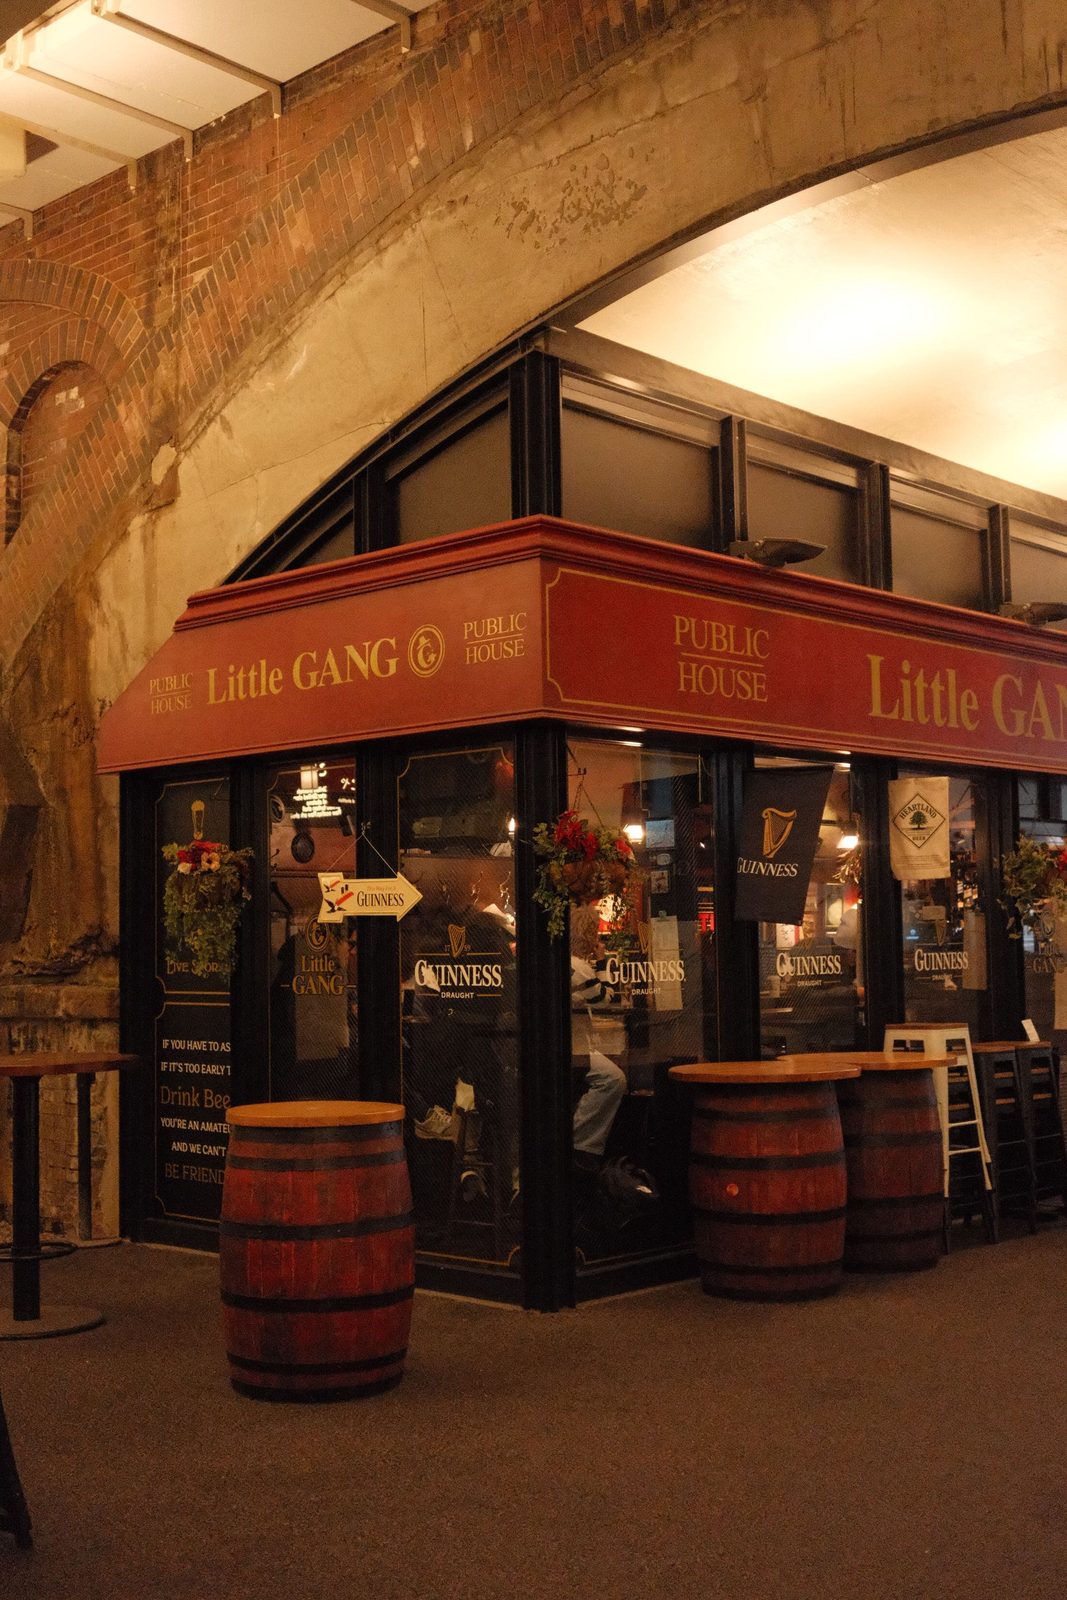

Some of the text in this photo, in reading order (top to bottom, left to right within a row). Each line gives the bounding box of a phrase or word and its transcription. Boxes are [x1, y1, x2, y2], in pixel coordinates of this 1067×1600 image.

[463, 612, 527, 640] PUBLIC
[673, 615, 770, 660] PUBLIC
[465, 638, 526, 666] HOUSE
[205, 637, 400, 705] Little GANG
[149, 672, 194, 695] PUBLIC
[677, 661, 769, 703] HOUSE
[866, 654, 979, 732] Little
[150, 694, 192, 715] HOUSE
[899, 803, 937, 820] HEARTLAND
[357, 891, 404, 907] GUINNESS
[300, 954, 336, 973] Little
[776, 952, 842, 977] GUINNESS
[914, 948, 969, 972] GUINNESS
[414, 959, 503, 988] GUINNESS
[606, 957, 685, 985] GUINNESS
[292, 975, 345, 996] GANG
[440, 991, 475, 1000] DRAUGHT
[631, 987, 661, 996] DRAUGHT
[162, 1039, 169, 1049] IF
[170, 1039, 186, 1050] YOU
[187, 1040, 207, 1052] HAVE
[208, 1041, 219, 1052] TO
[160, 1061, 168, 1072] IF
[168, 1062, 183, 1073] IT'S
[184, 1063, 200, 1074] TOO
[201, 1064, 225, 1076] EARLY
[160, 1085, 200, 1107] Drink
[160, 1117, 187, 1130] YOU'RE
[187, 1120, 199, 1131] AN
[171, 1141, 227, 1157] AND WE CAN'T
[165, 1163, 179, 1179] BE
